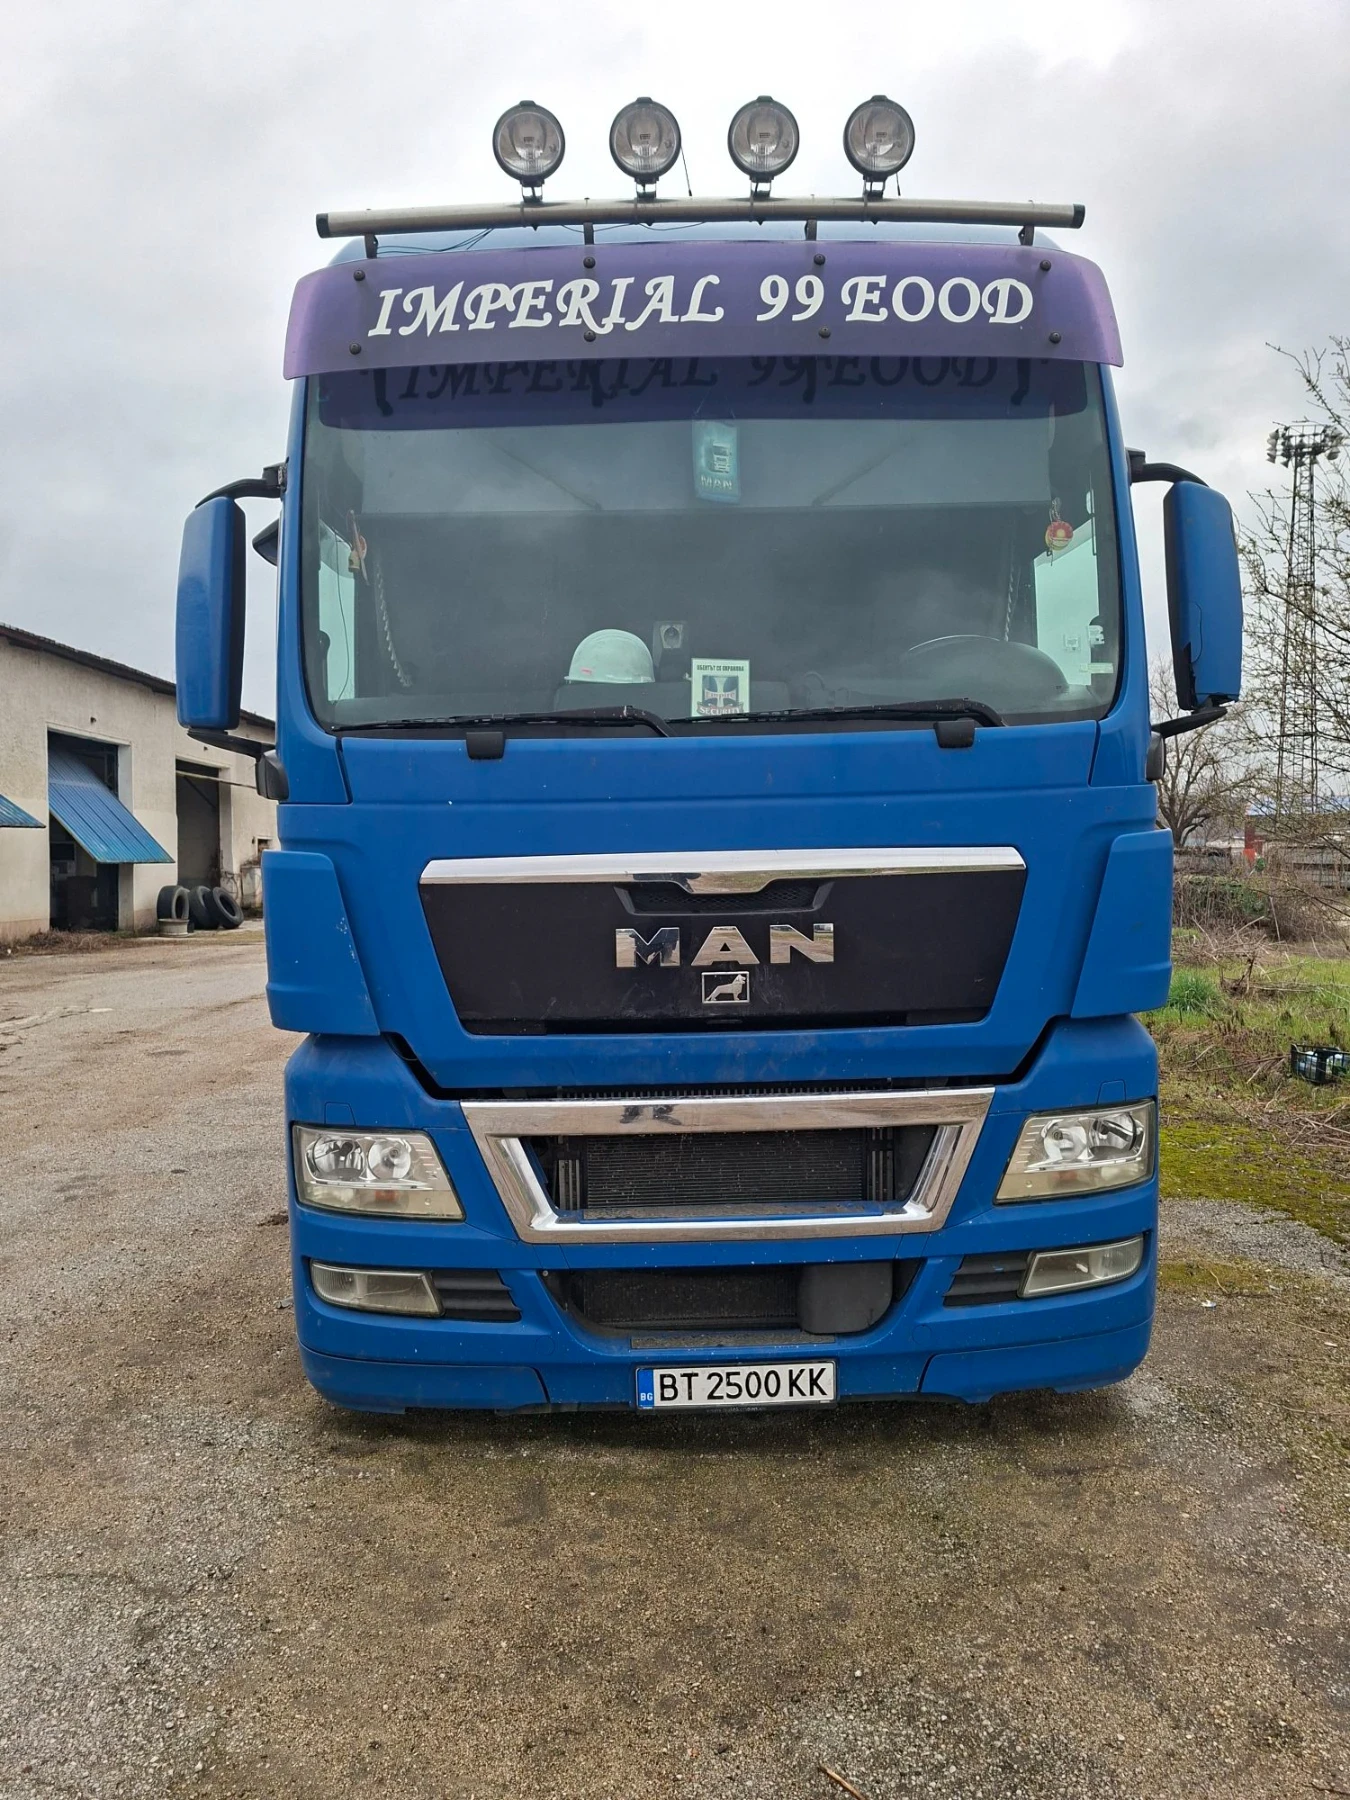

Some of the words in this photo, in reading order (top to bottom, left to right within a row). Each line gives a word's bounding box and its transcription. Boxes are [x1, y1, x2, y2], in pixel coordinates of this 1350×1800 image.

[367, 274, 724, 337] IMPERIAL
[756, 274, 825, 321] 99
[841, 274, 1034, 324] EOOD
[615, 923, 834, 968] MAN
[640, 1393, 653, 1401] BG
